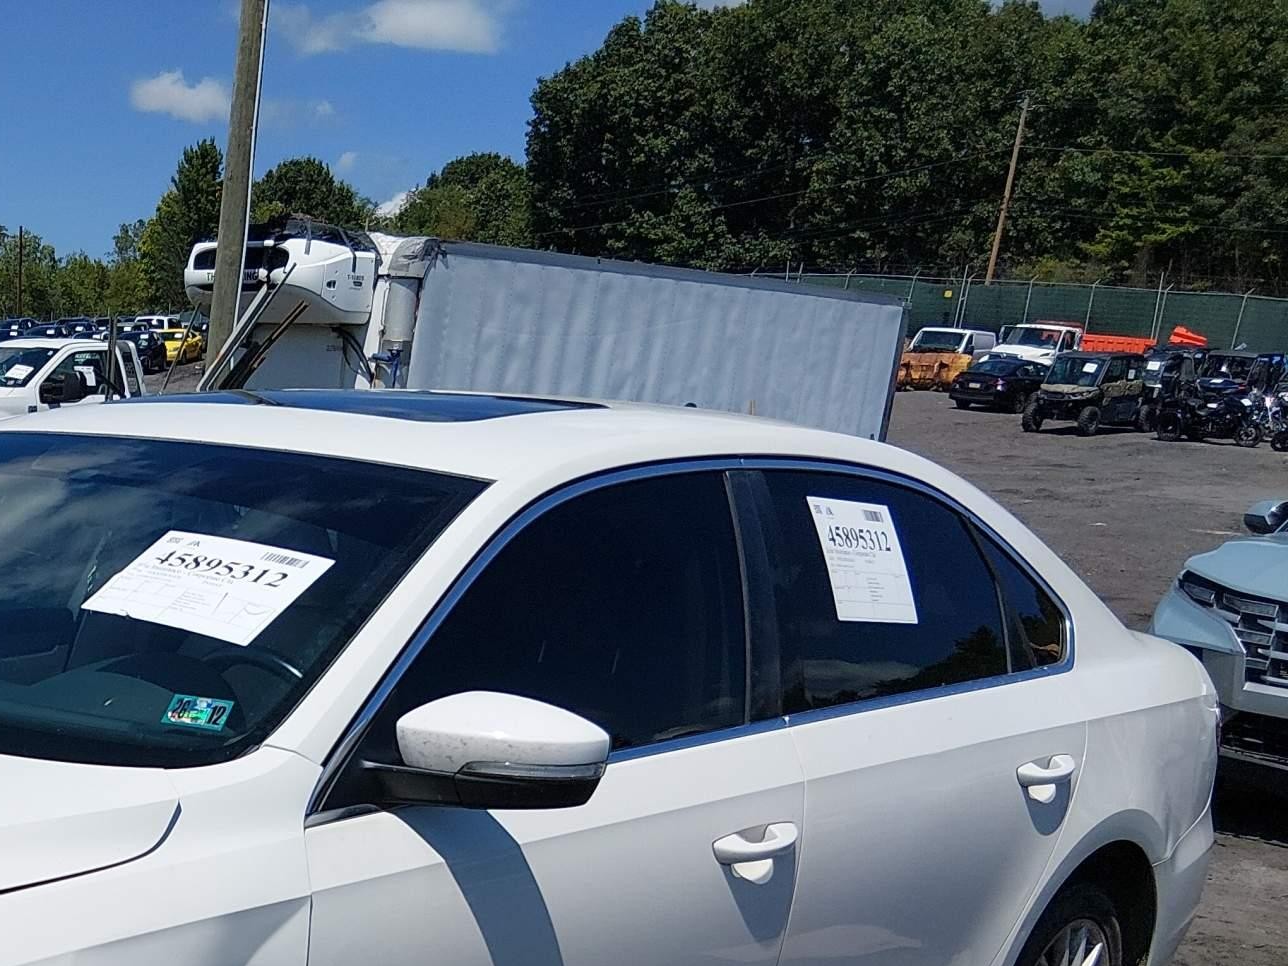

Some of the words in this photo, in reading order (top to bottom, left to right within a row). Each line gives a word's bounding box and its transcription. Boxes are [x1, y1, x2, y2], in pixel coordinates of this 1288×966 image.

[828, 526, 891, 551] 45895312
[156, 551, 288, 587] 45895312
[208, 706, 226, 725] 12
